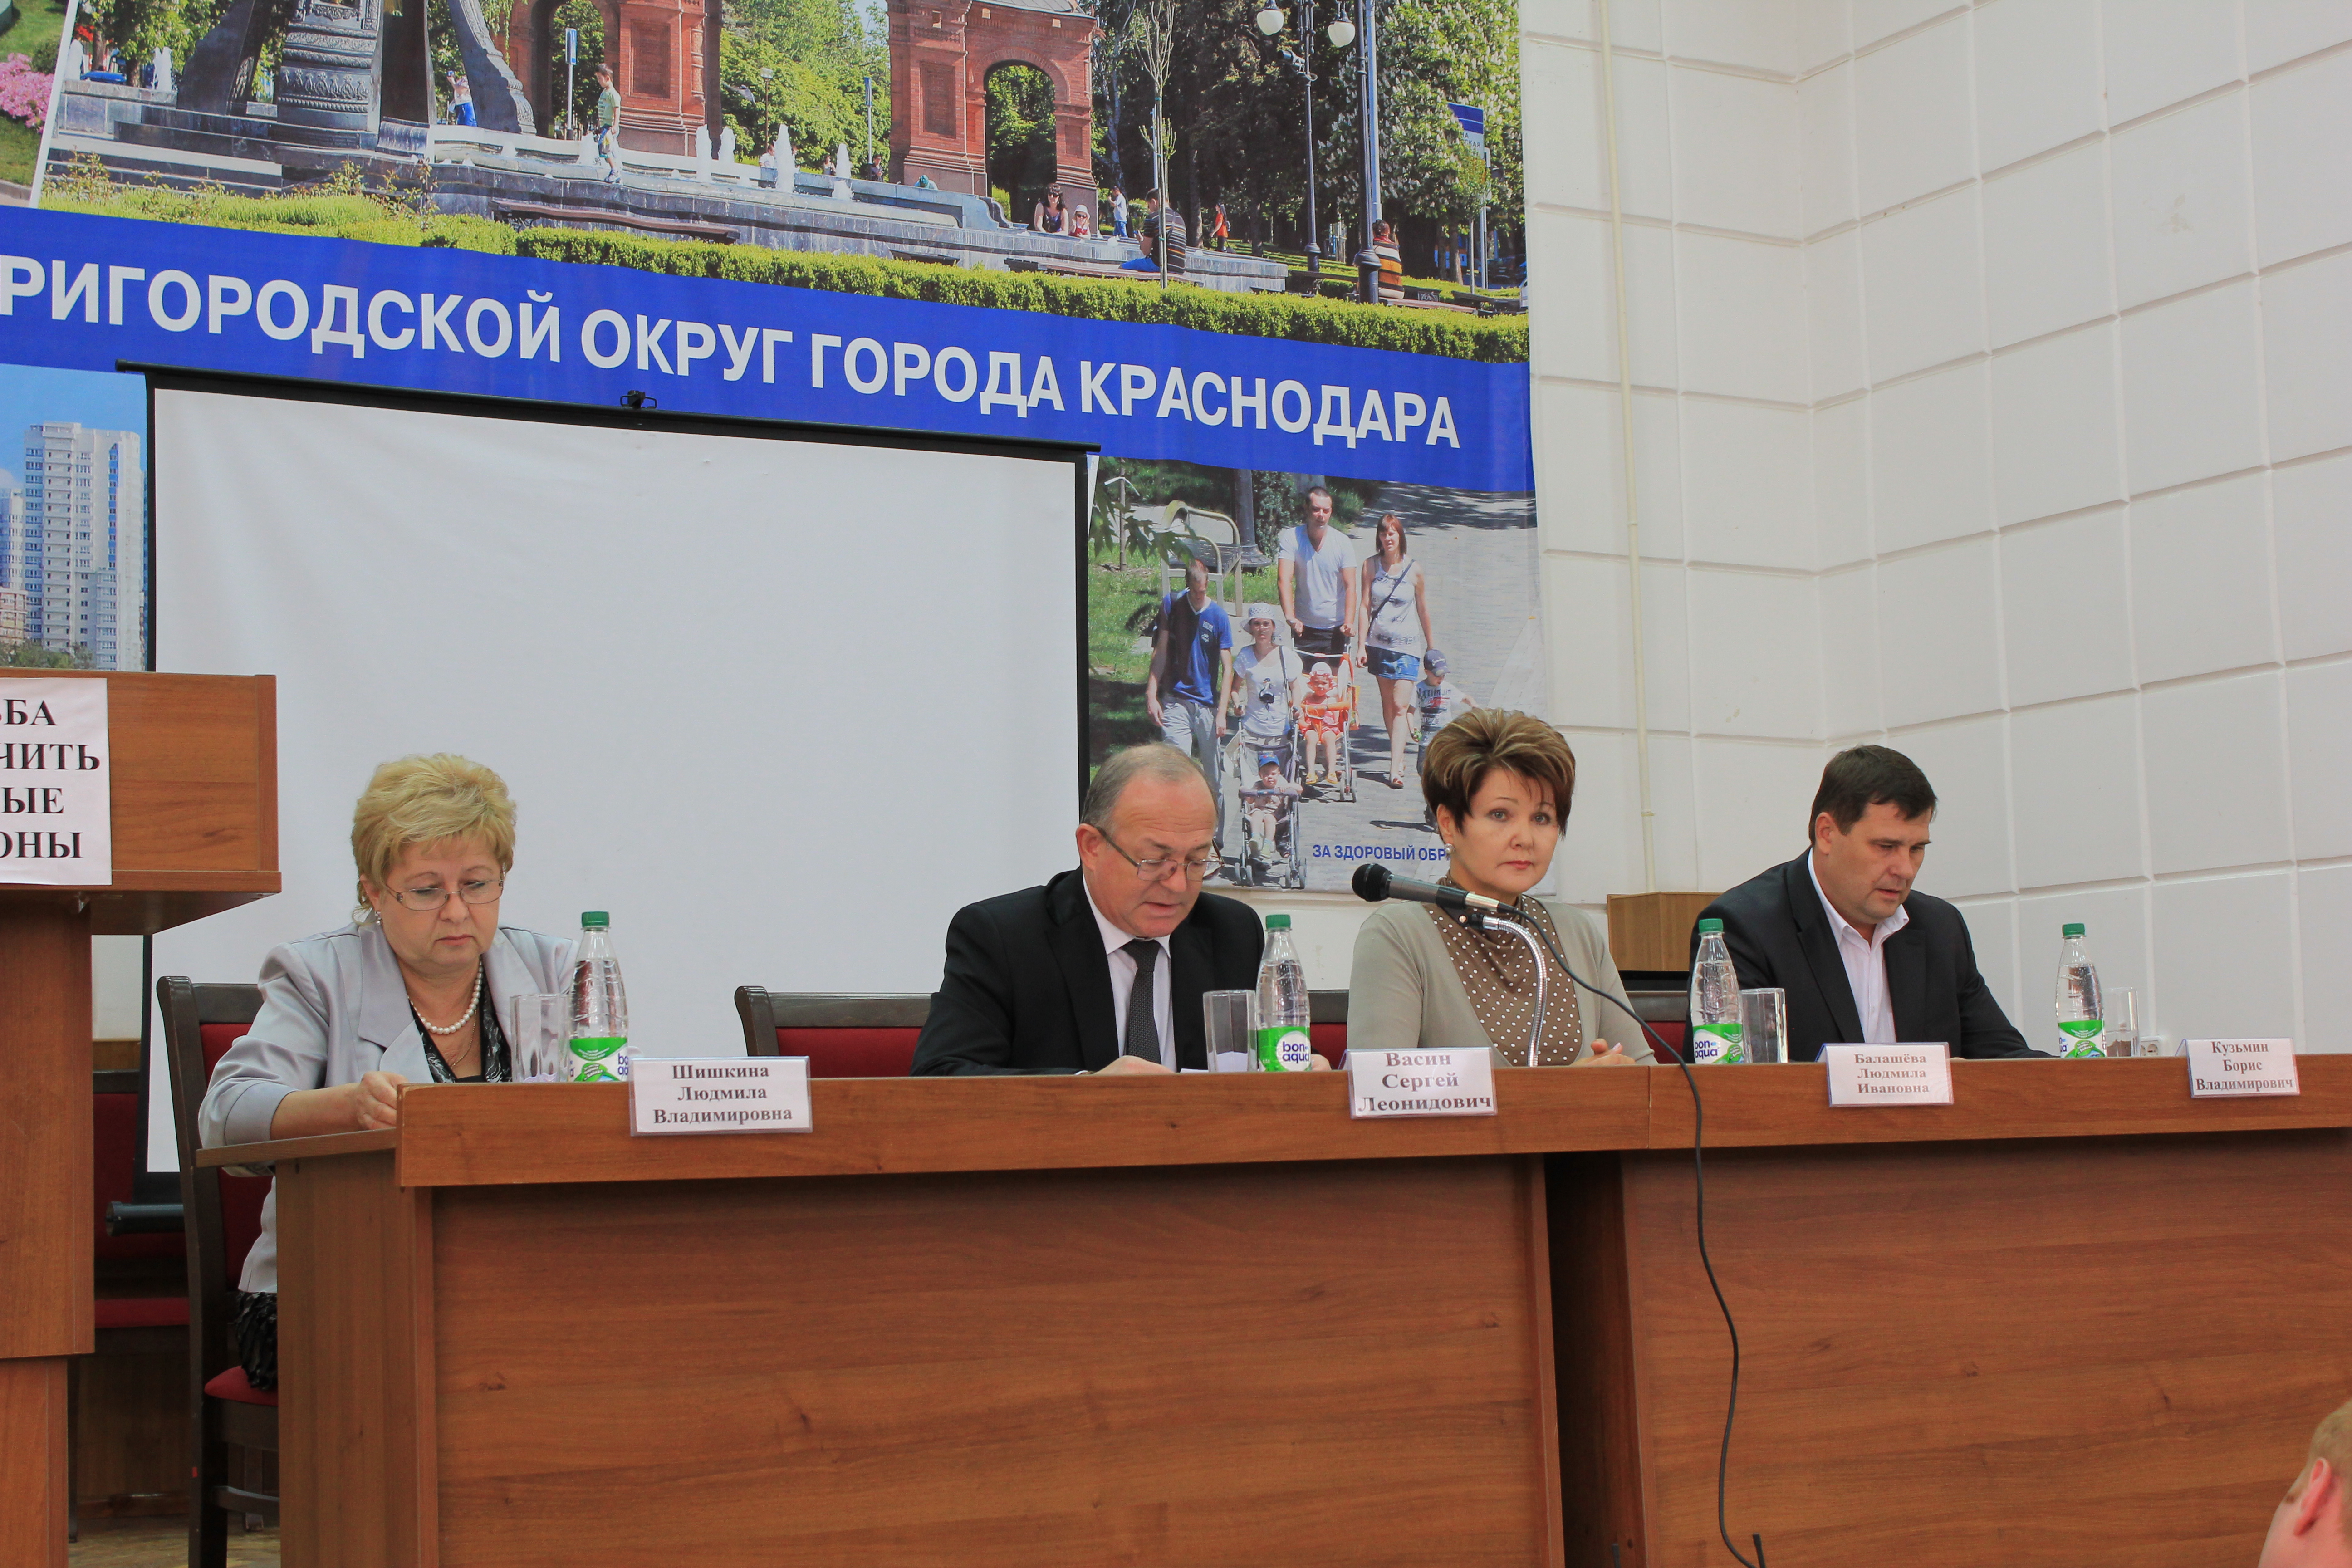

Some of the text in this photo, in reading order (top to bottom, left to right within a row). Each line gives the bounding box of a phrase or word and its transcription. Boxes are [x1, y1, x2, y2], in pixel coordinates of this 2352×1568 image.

[0, 255, 1460, 449] РИГОРОДСКОЙ ОКРУГ ГОРОДА КРАСНОДАРА
[0, 699, 58, 726] БА
[1, 787, 64, 814] ЫЕ
[1313, 844, 1331, 858] ЗА
[1334, 844, 1415, 861] ЗДОРОВЫЙ
[2211, 1041, 2269, 1056] Кузьмин
[1386, 1053, 1451, 1067] Васин
[1854, 1054, 1927, 1064] Балашёва
[2222, 1059, 2263, 1074] Борис
[672, 1064, 769, 1079] Шишкина
[1857, 1068, 1926, 1079] Людмила
[1382, 1073, 1459, 1092] Сергей
[1857, 1083, 1929, 1094] Ивановна
[2195, 1078, 2293, 1092] Владимирович
[677, 1087, 767, 1101] Людмила
[1358, 1097, 1492, 1112] Леонидович
[653, 1108, 793, 1125] Владимировна
